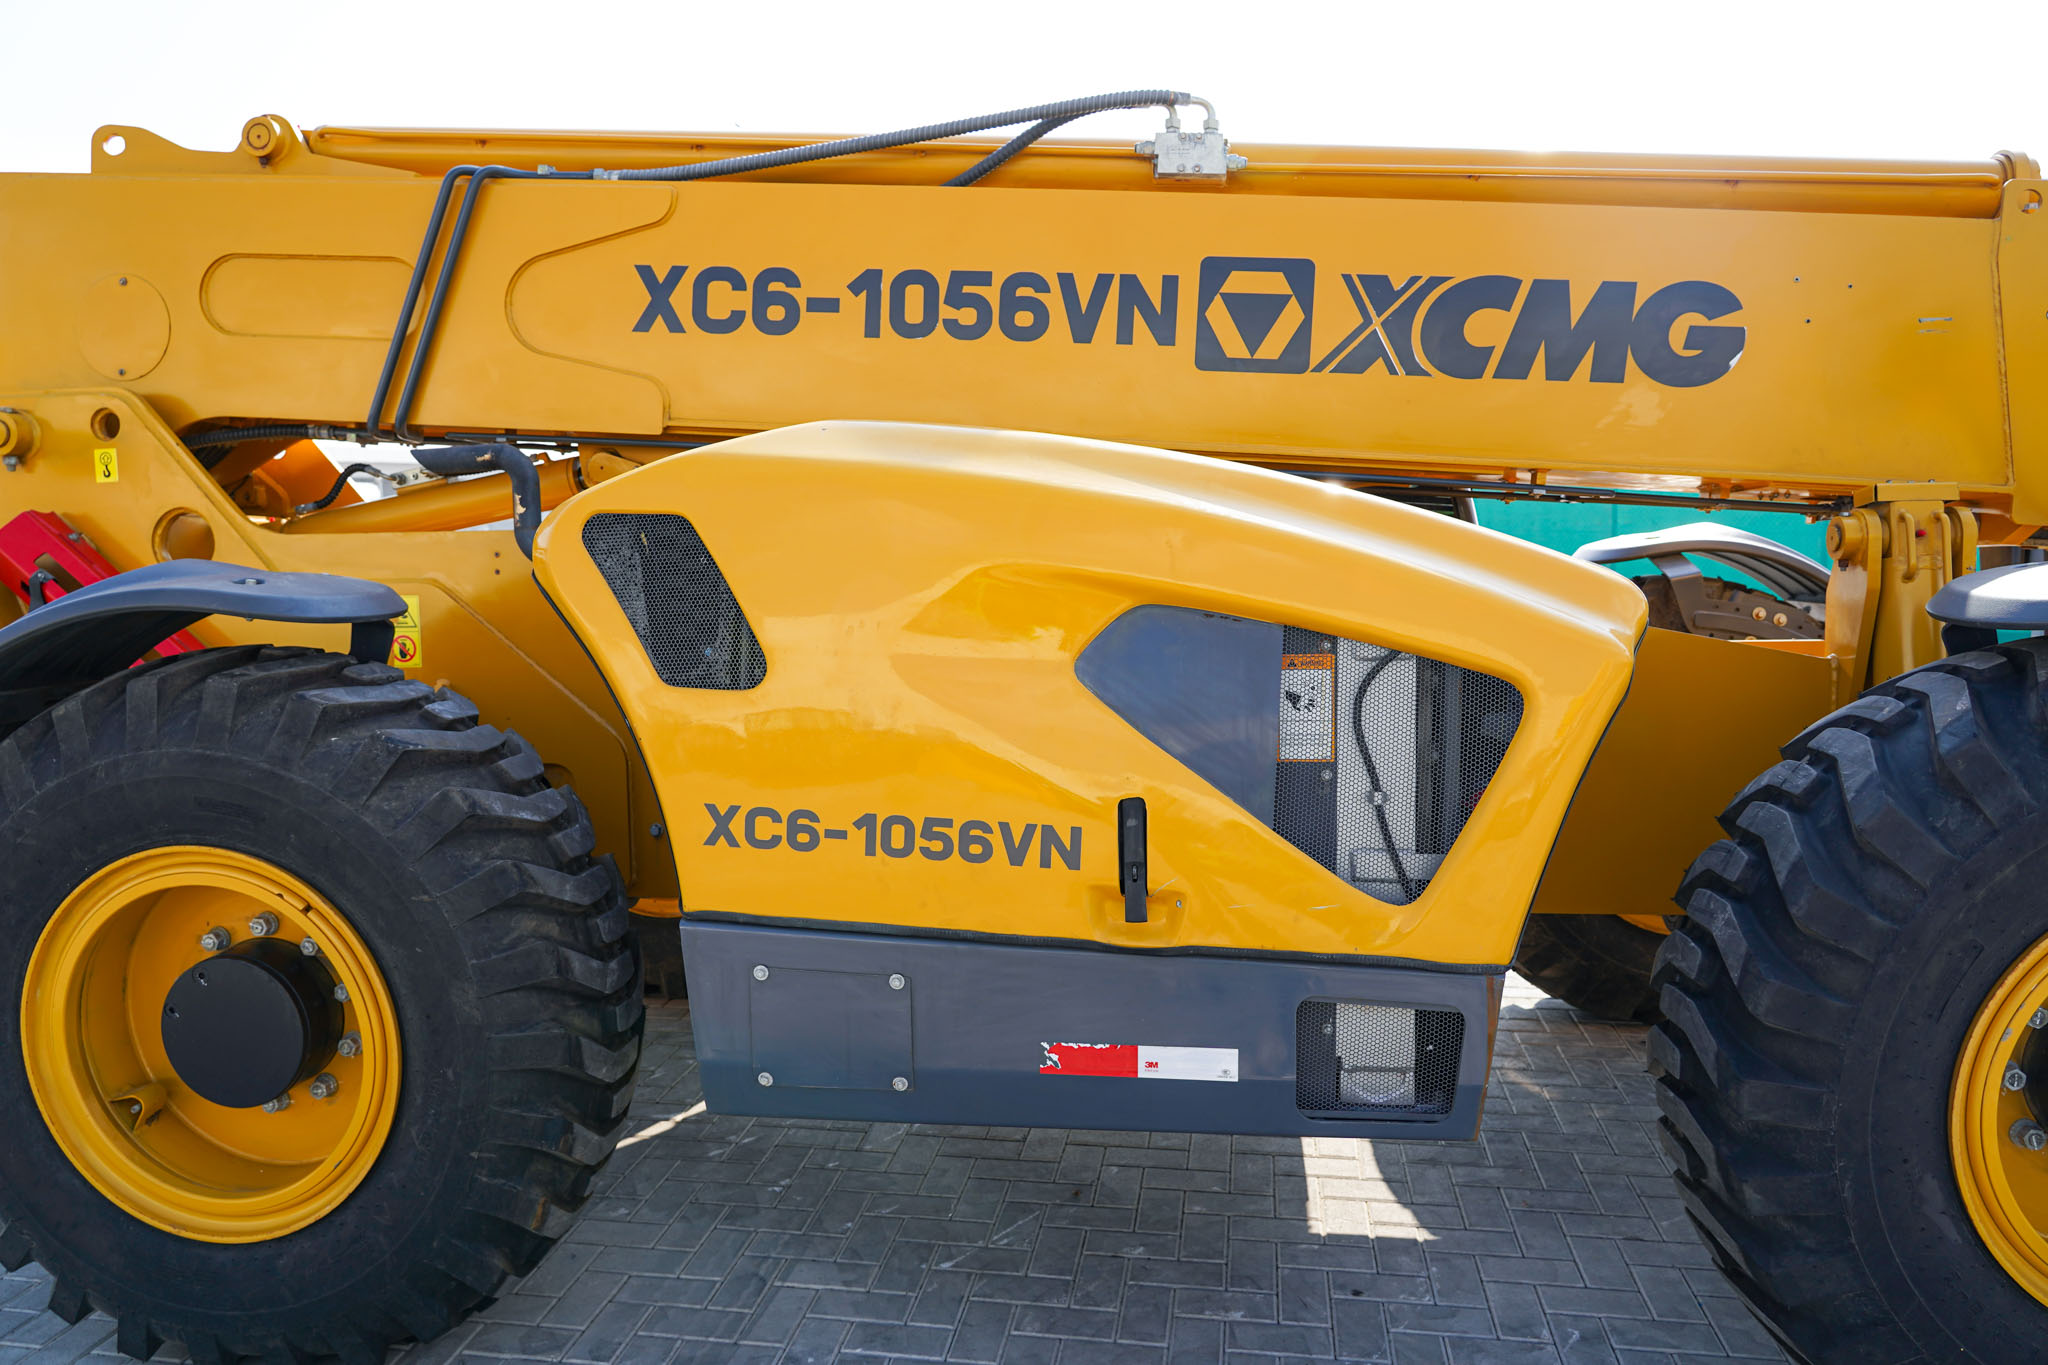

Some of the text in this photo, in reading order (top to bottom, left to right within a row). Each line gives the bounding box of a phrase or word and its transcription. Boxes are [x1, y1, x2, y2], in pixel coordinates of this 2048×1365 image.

[632, 265, 1179, 348] XC6-1056VN
[1310, 273, 1747, 388] XCMG
[704, 804, 1083, 871] XC6-1056VN
[1144, 1061, 1159, 1069] 3M
